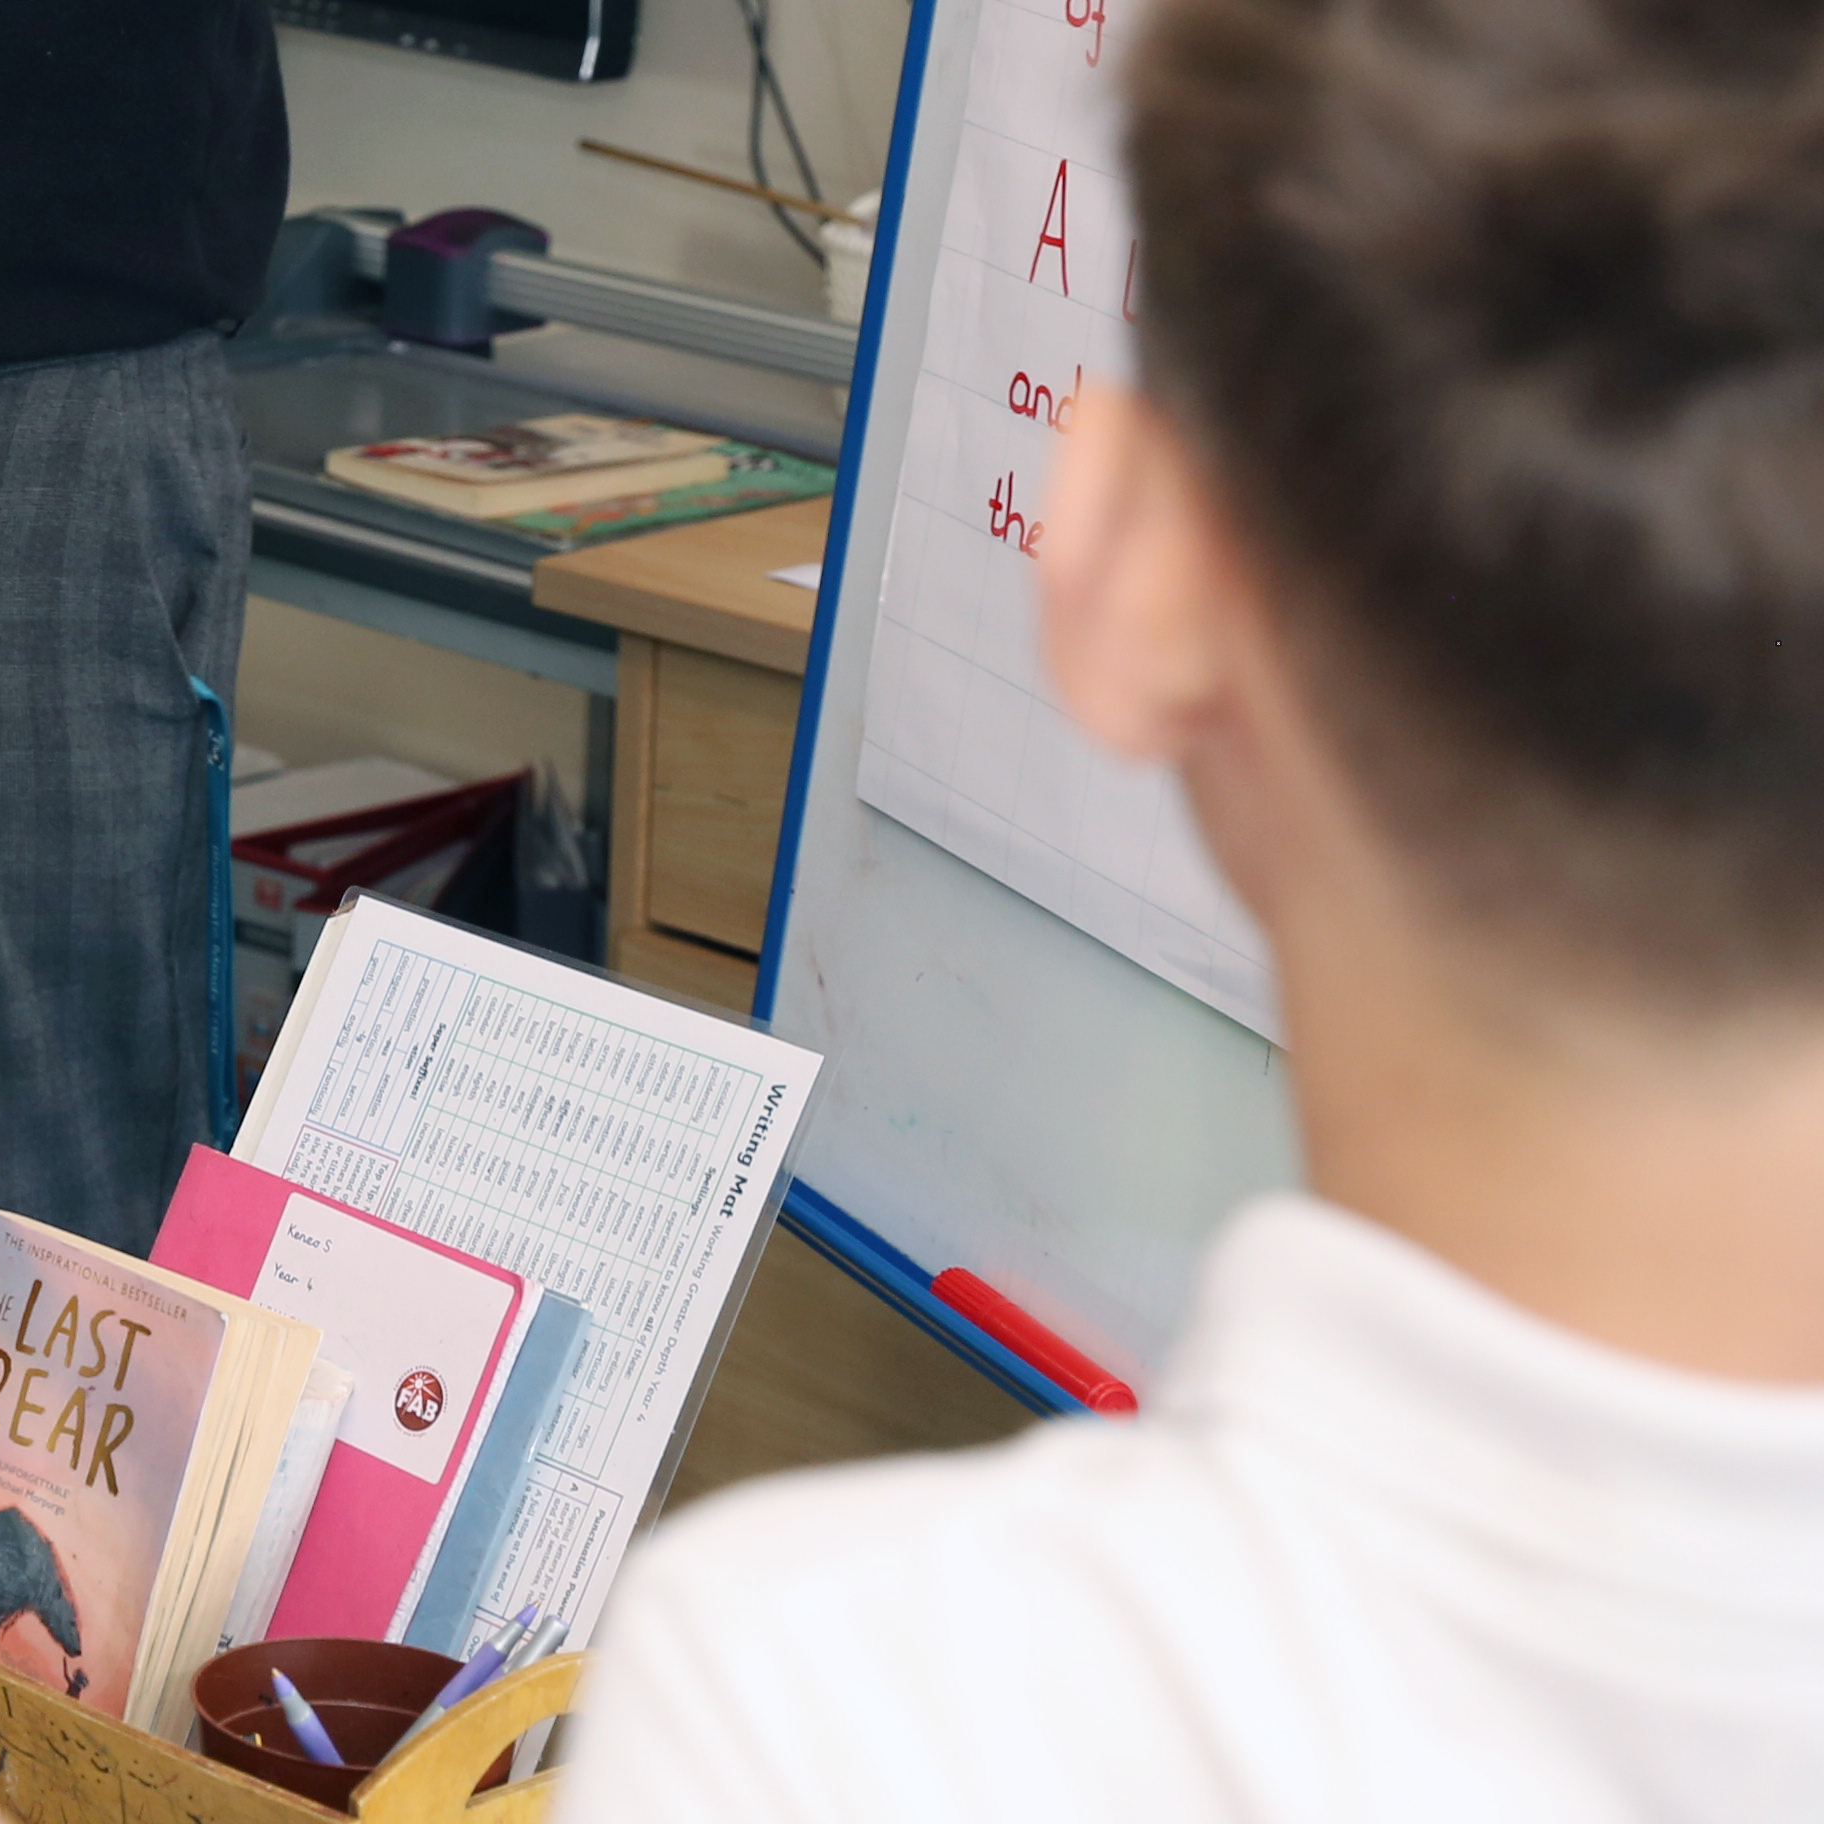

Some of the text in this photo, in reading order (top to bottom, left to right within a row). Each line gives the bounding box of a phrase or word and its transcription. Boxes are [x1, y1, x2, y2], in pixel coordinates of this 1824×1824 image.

[1030, 160, 1068, 295] A
[987, 472, 1045, 560] the
[359, 954, 380, 987] gently
[381, 952, 411, 1008] courageous
[403, 976, 431, 1033] preparation
[334, 1011, 357, 1049] angrily
[354, 1030, 368, 1045] -ly
[363, 1022, 383, 1059] curious
[380, 1036, 393, 1058] -ous
[561, 1028, 585, 1065] bicycle
[404, 1042, 420, 1071] -ation
[410, 1022, 448, 1100] Super Suffixes!
[307, 1064, 338, 1117] frantically
[339, 1083, 358, 1118] serious
[368, 1073, 392, 1118] sensation
[662, 1062, 687, 1104] actually
[688, 1064, 721, 1124] accidentally
[710, 1079, 732, 1121] accident
[517, 1084, 544, 1131] disappear
[536, 1094, 557, 1132] difficult
[550, 1098, 572, 1138] different
[619, 1122, 645, 1167] complete
[640, 1137, 657, 1165] circle
[654, 1139, 673, 1174] certain
[665, 1140, 689, 1181] century
[365, 1162, 390, 1205] Top Tip:
[685, 1151, 703, 1183] centre
[577, 1183, 605, 1229] February
[607, 1197, 633, 1236] famous
[626, 1204, 646, 1243] extreme
[634, 1200, 664, 1257] experiment
[651, 1209, 679, 1261] experience
[623, 1166, 718, 1380] Spellings... I need to know all of these:
[635, 1083, 787, 1423] Writing Mat Working Greater Depth Year 4
[5, 1232, 188, 1321] THE INSPIRATIONAL BESTSELLER
[272, 1262, 314, 1291] Year 4
[599, 1276, 619, 1308] island
[613, 1279, 634, 1317] interest
[623, 1279, 652, 1329] important
[16, 1279, 151, 1391] LAST
[570, 1338, 591, 1380] peculiar
[584, 1339, 609, 1390] particular
[596, 1347, 622, 1393] ordinary
[397, 1388, 438, 1422] FAB
[542, 1403, 564, 1446] sentence
[557, 1406, 582, 1456] remember
[573, 1421, 592, 1450] reign
[25, 1488, 66, 1516] Morpurgo
[569, 1481, 580, 1493] A
[505, 1484, 533, 1537] a sentence.
[534, 1496, 562, 1551] and places.
[489, 1488, 544, 1605] A full stop at the end of
[530, 1501, 571, 1587] start of sentences,
[541, 1505, 582, 1592] Capital letters for
[571, 1508, 607, 1580] Punctuation
